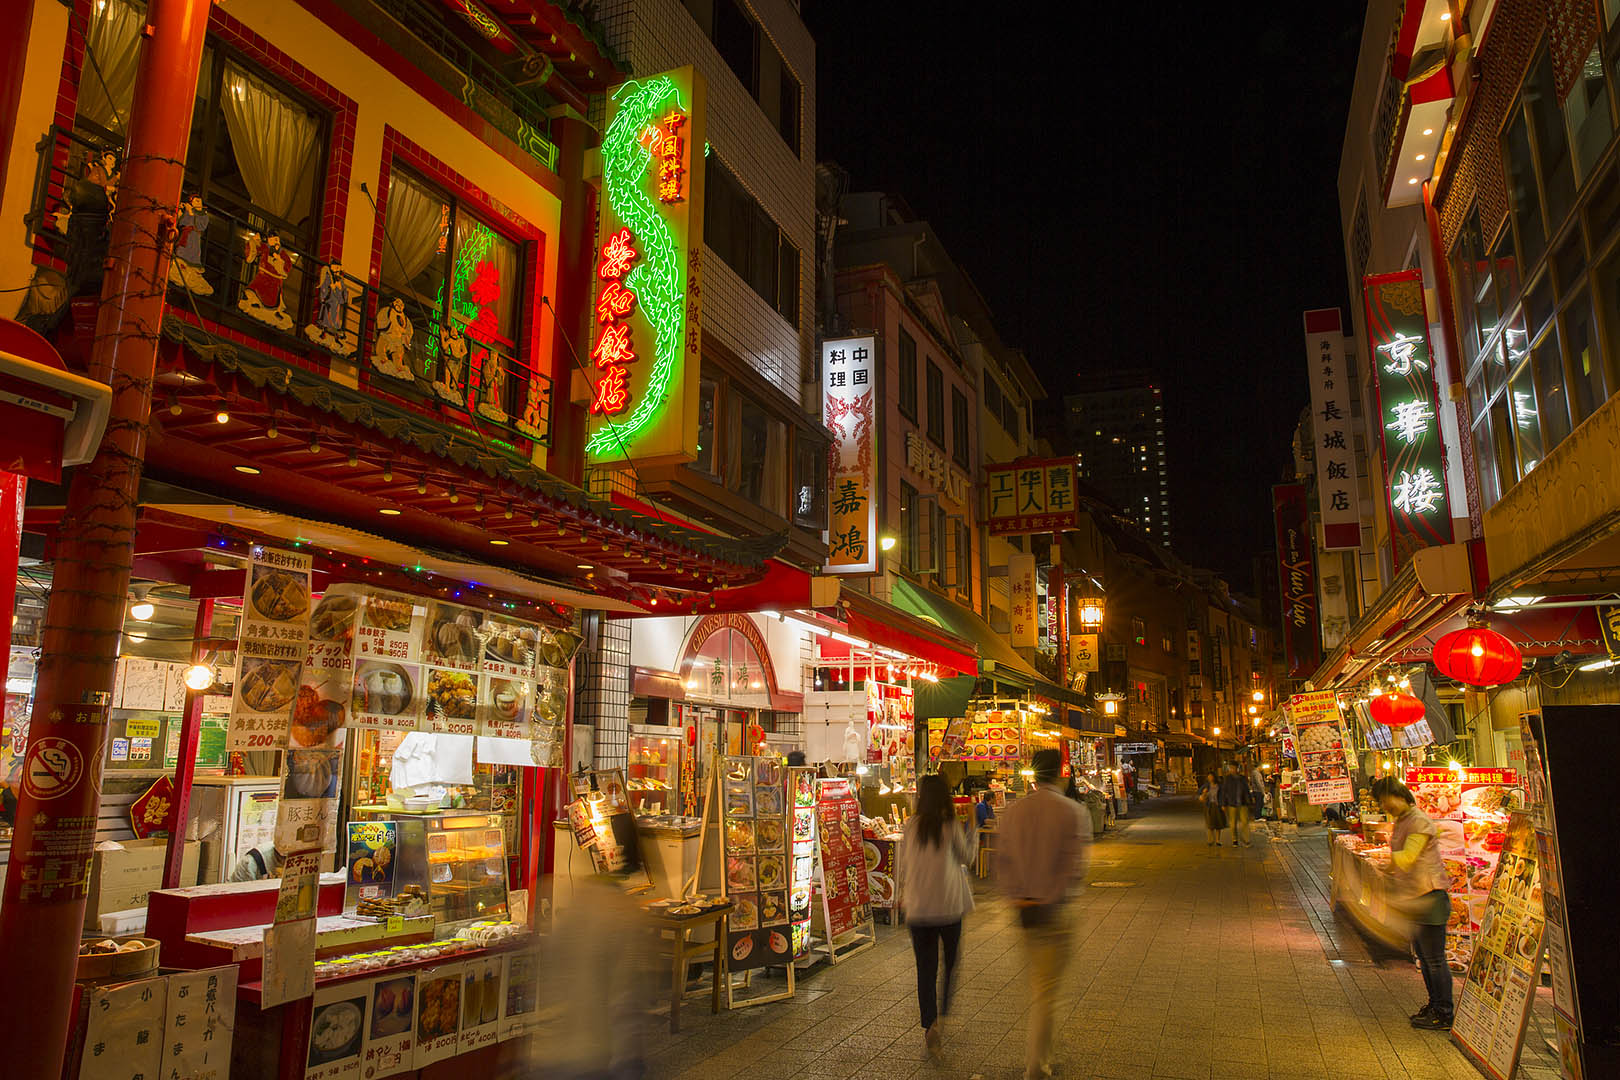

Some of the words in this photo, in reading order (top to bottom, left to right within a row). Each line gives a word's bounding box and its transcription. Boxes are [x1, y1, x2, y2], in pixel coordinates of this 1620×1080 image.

[659, 110, 685, 202] 中国料理
[830, 349, 846, 387] 料理
[853, 347, 868, 385] 中国
[1377, 333, 1443, 515] 京華楼
[1320, 400, 1350, 512] 長城飯店
[992, 473, 1014, 514] 工厂
[1020, 471, 1043, 512] 华人
[1049, 468, 1073, 509] 青年
[831, 481, 867, 560] 嘉鴻
[692, 613, 725, 653] CHINESE
[728, 612, 769, 667] RESTAURANT
[288, 806, 328, 821] 豚まん
